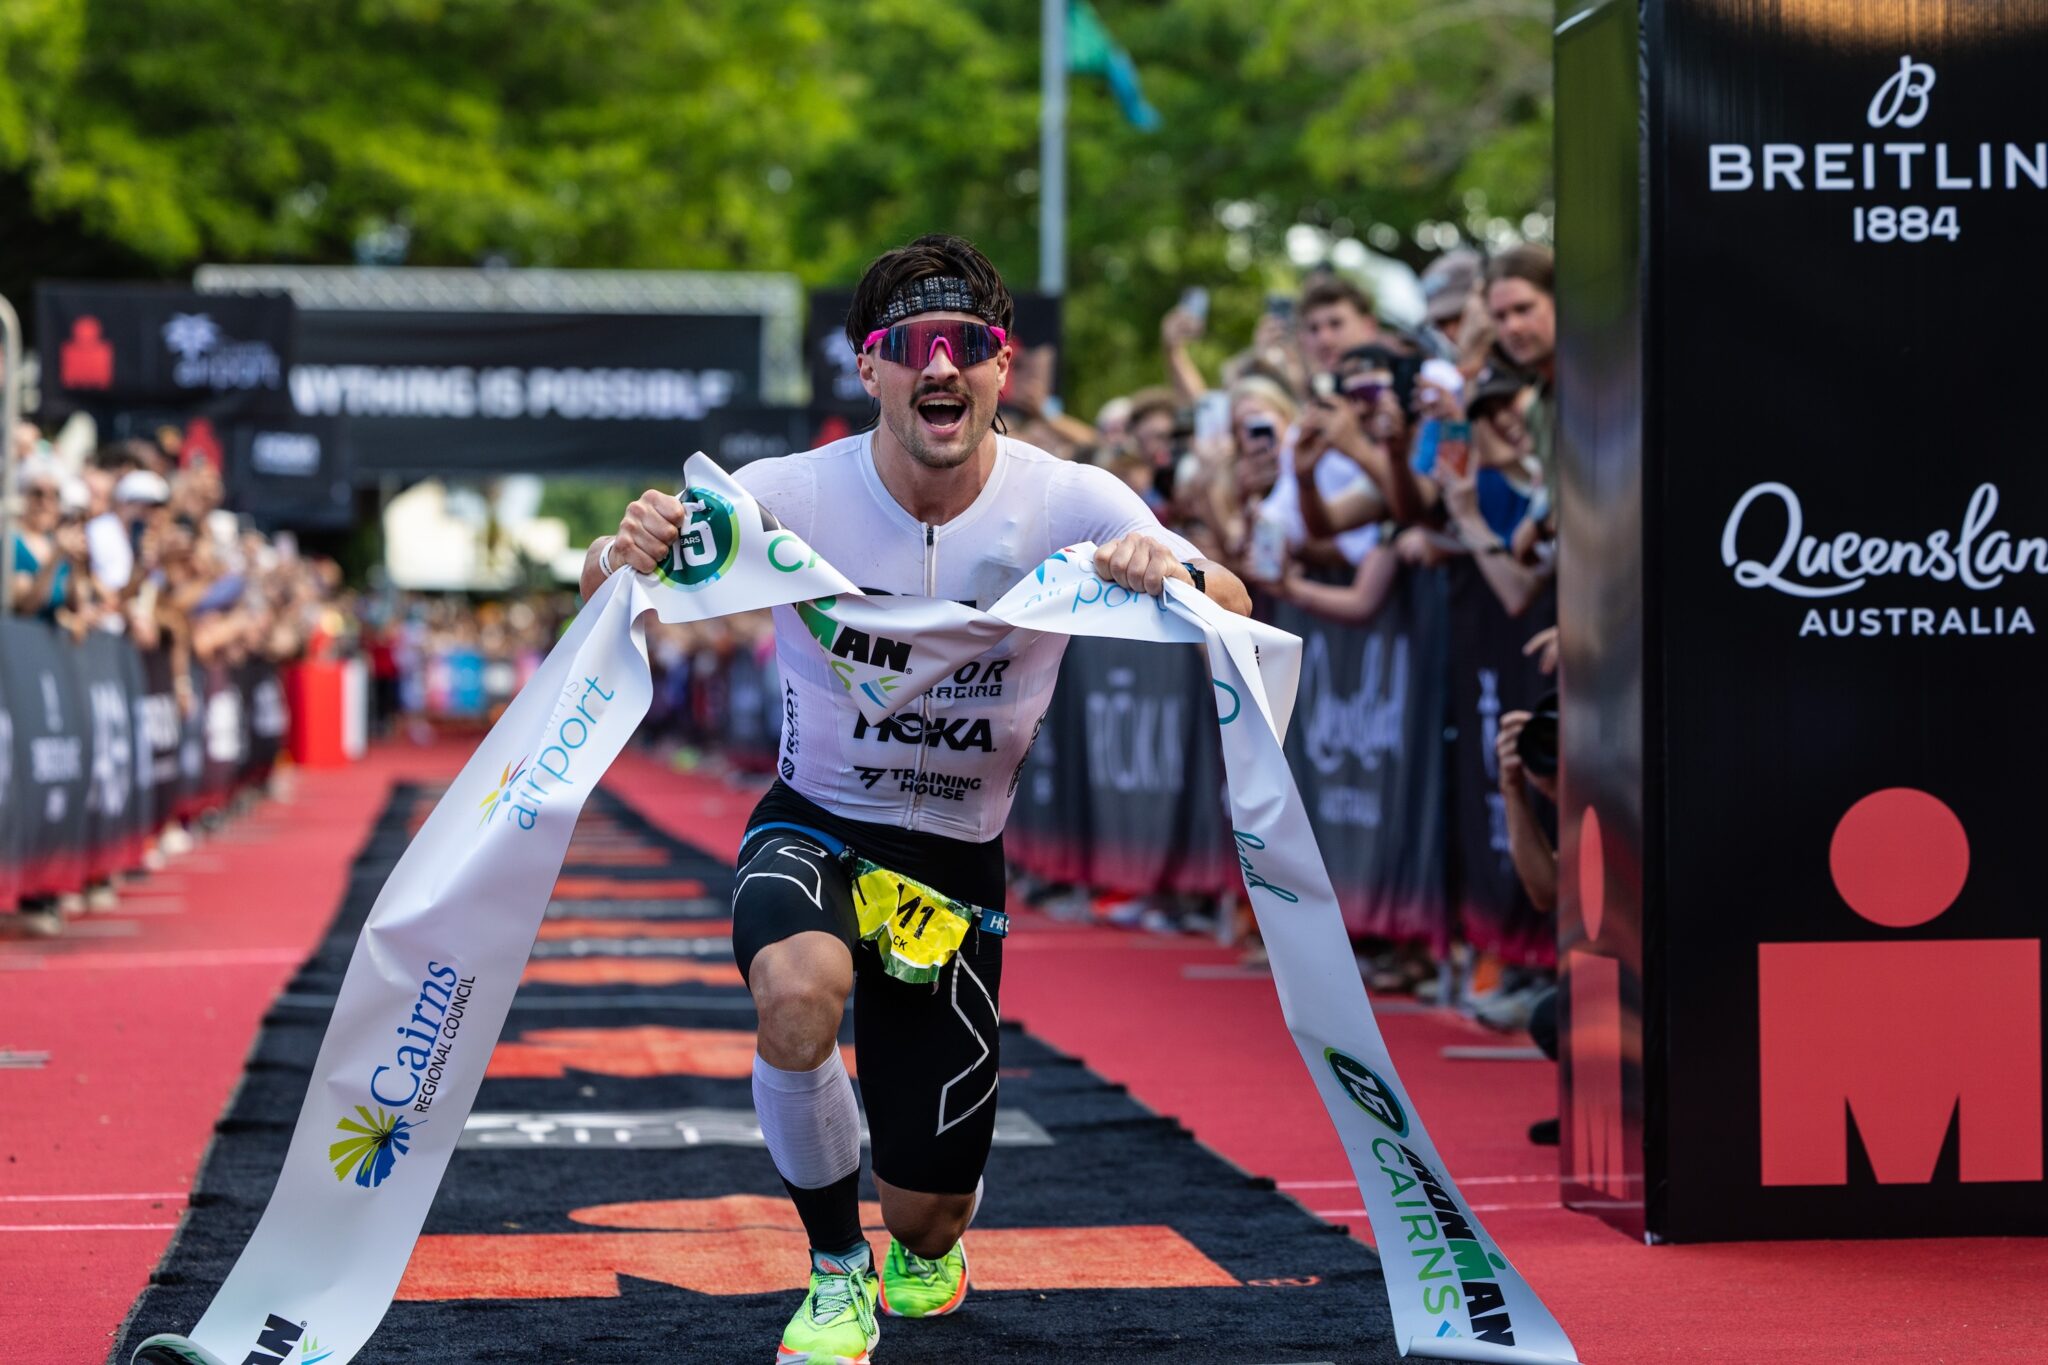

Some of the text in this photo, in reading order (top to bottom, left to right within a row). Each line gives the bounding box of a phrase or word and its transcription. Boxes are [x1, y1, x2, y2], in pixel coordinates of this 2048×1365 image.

[1709, 143, 2047, 191] BREITLIN
[1853, 206, 1960, 242] 1884
[1721, 482, 2048, 597] Queenslan
[1799, 607, 2035, 637] AUSTRALIA
[507, 676, 615, 831] airport
[786, 678, 795, 755] RUDY
[890, 768, 982, 790] TRAINING
[900, 782, 966, 801] HOUSE
[370, 961, 457, 1107] Cairns
[414, 975, 476, 1113] REGIONAL COUNCIL
[1371, 1137, 1460, 1315] CAIRNS
[1398, 1142, 1516, 1347] IRONMAN
